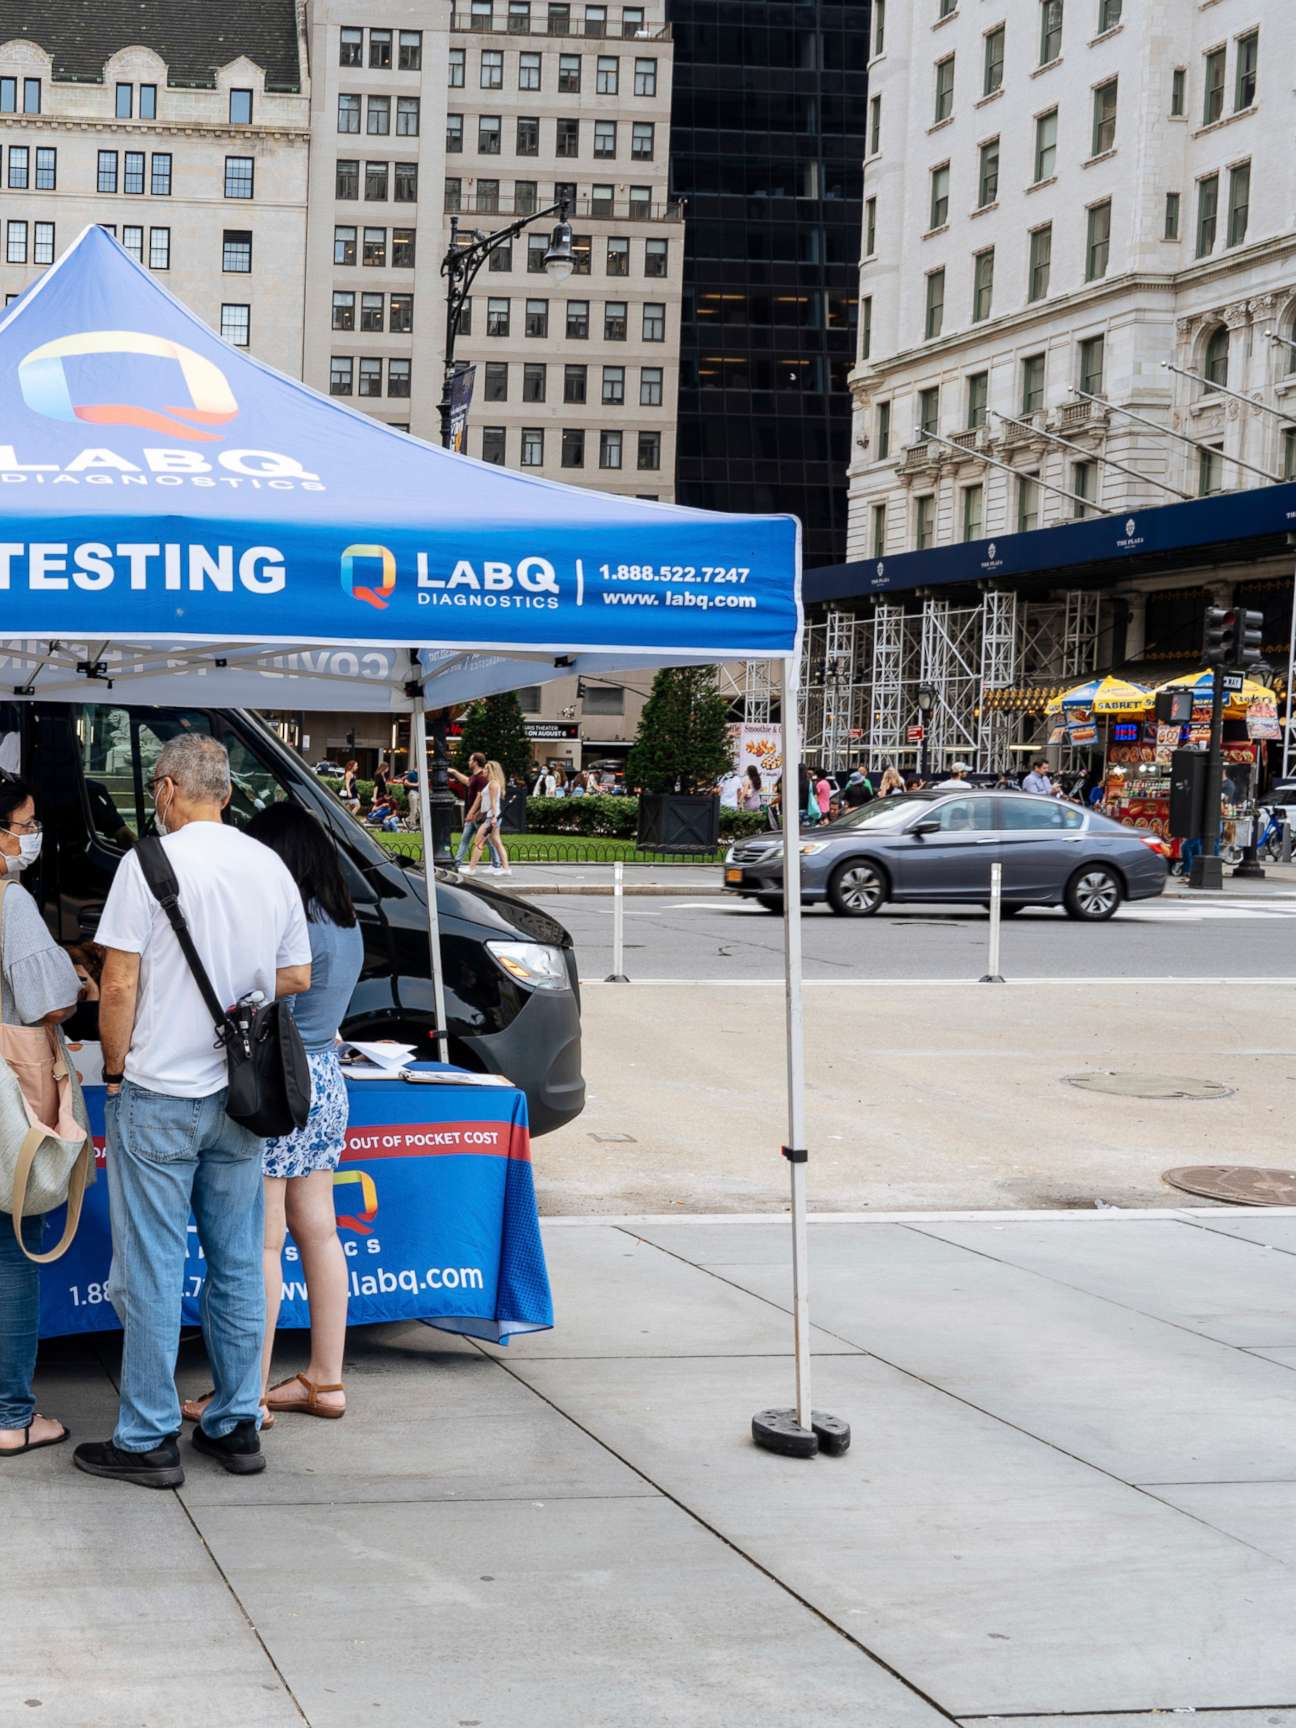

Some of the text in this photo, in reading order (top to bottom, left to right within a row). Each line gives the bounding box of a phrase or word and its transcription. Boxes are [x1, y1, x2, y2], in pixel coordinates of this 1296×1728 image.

[0, 472, 327, 492] DIAGNOSTICS
[416, 551, 560, 594] LABQ
[599, 563, 750, 585] 1.888.522.7247
[417, 592, 560, 610] DIAGNOSTICS
[665, 590, 757, 612] labq.com
[350, 1137, 380, 1150] OUT
[385, 1135, 402, 1147] OF
[406, 1131, 461, 1147] POCKET
[464, 1131, 499, 1144] COST
